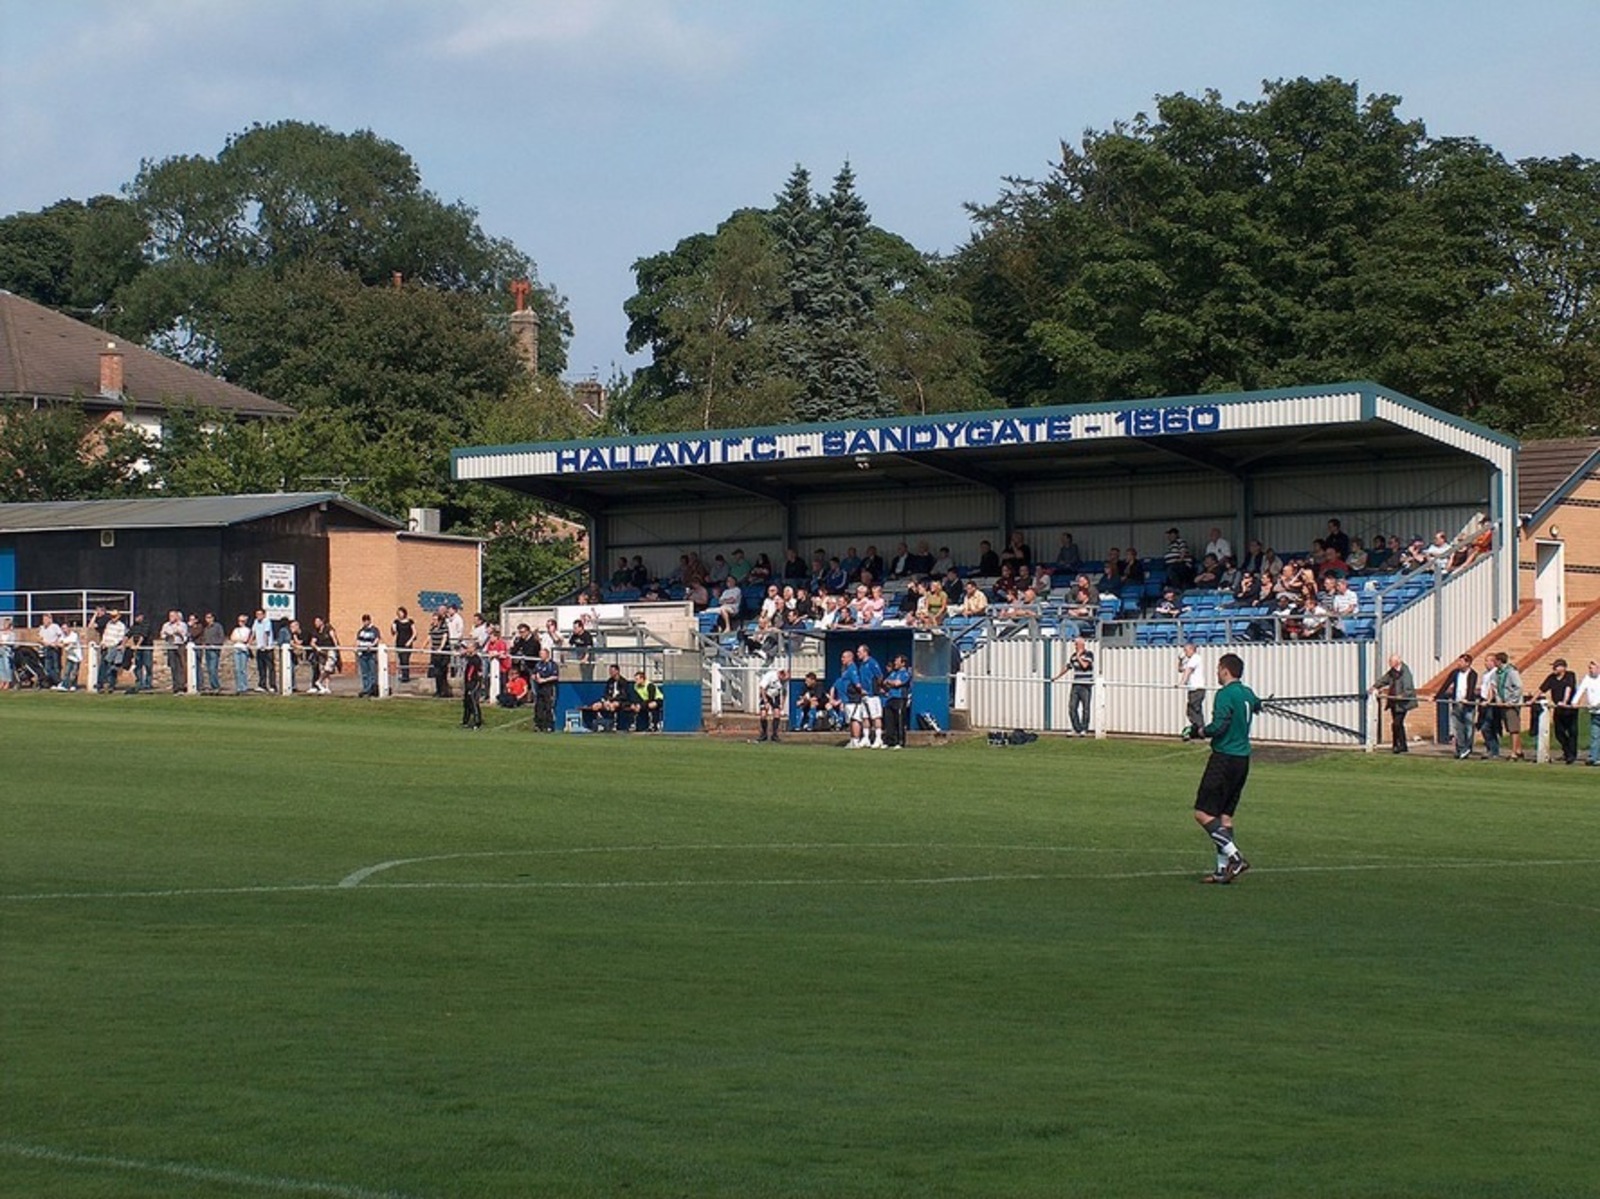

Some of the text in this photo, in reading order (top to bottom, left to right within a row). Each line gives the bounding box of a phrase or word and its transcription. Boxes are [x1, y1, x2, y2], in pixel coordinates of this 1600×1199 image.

[557, 441, 710, 473] HALLAM
[822, 415, 1072, 455] SANDYGATE
[1115, 406, 1219, 437] 1860
